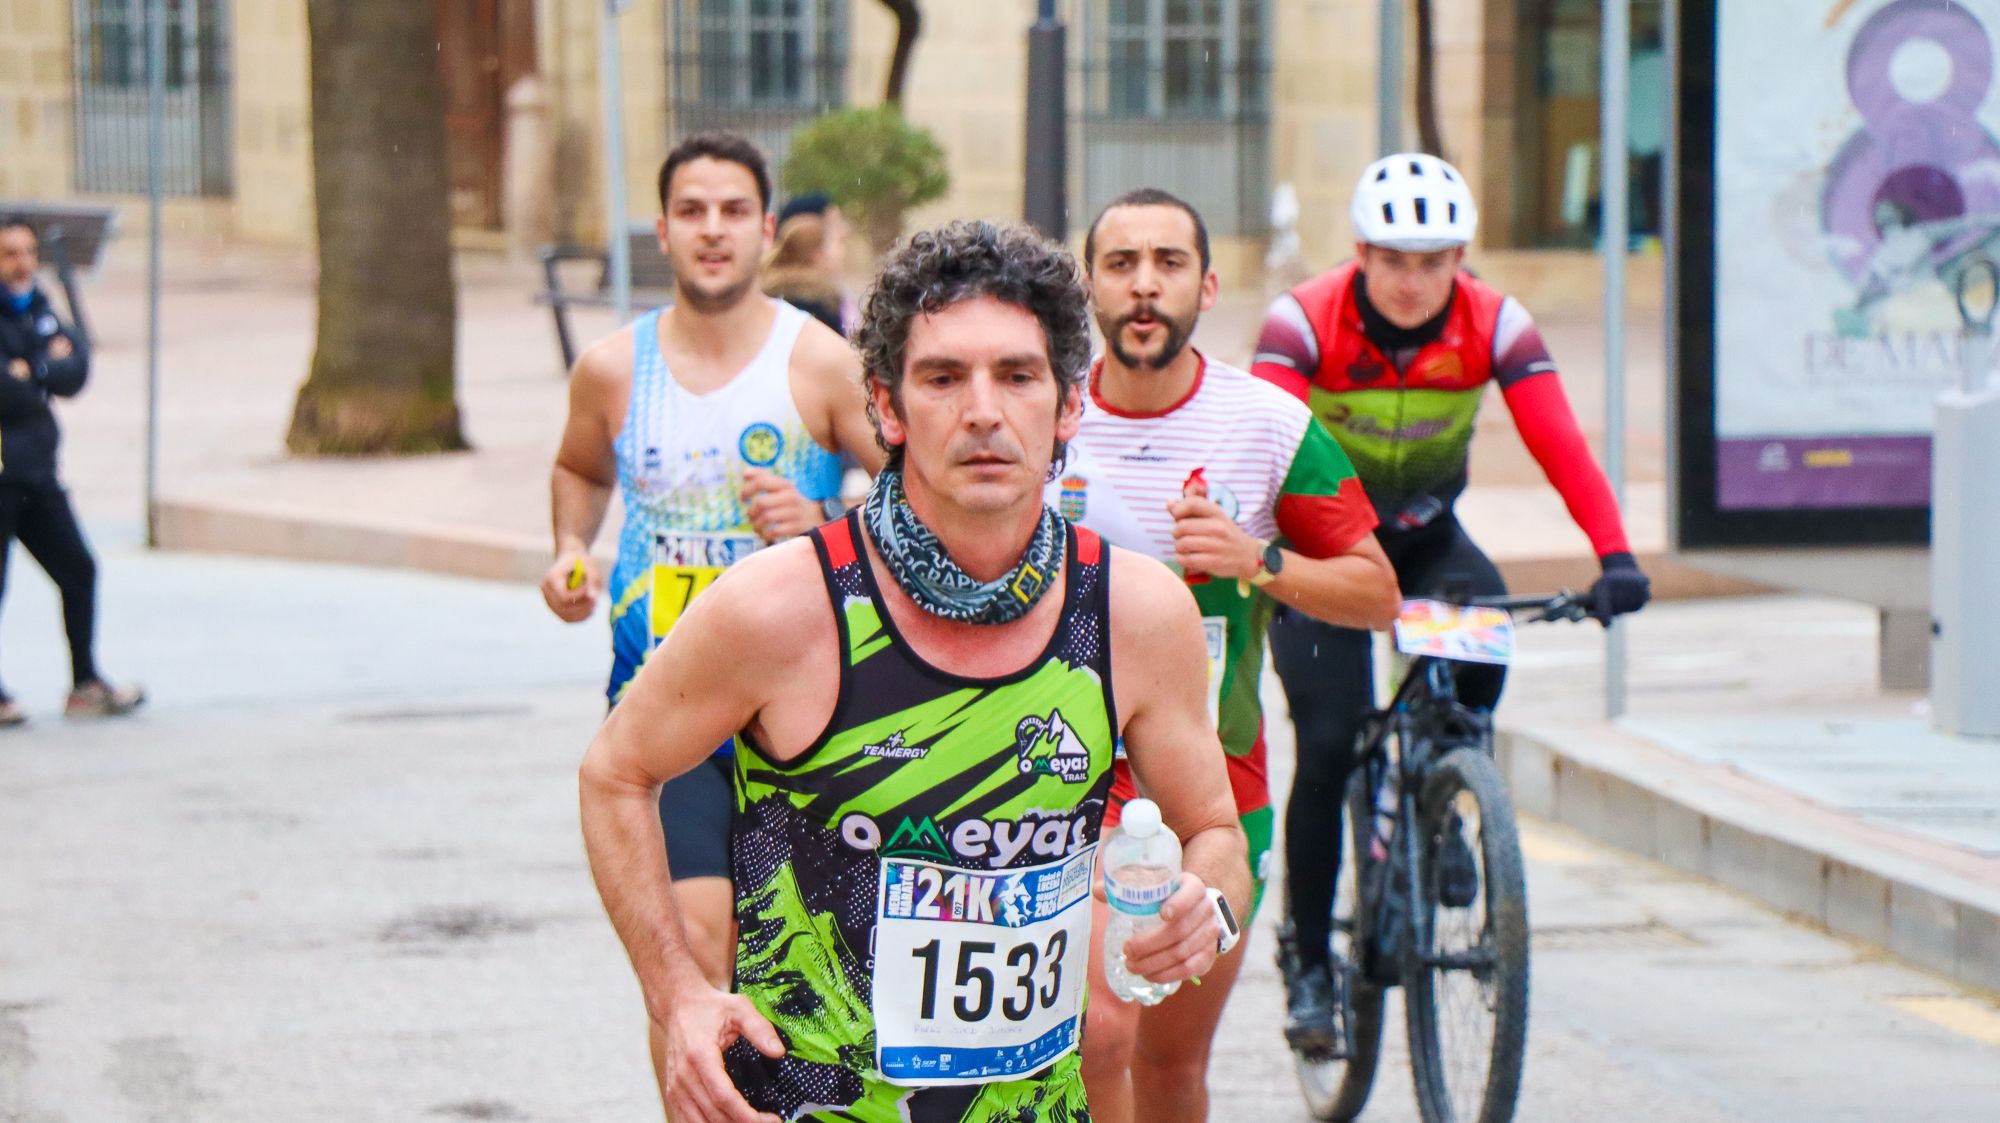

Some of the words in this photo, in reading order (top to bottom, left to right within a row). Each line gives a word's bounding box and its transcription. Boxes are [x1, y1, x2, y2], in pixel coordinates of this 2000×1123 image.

[863, 745, 929, 759] TEAMERGY
[1063, 773, 1087, 782] TRAIL
[916, 866, 996, 922] 21K
[911, 928, 1069, 1022] 1533
